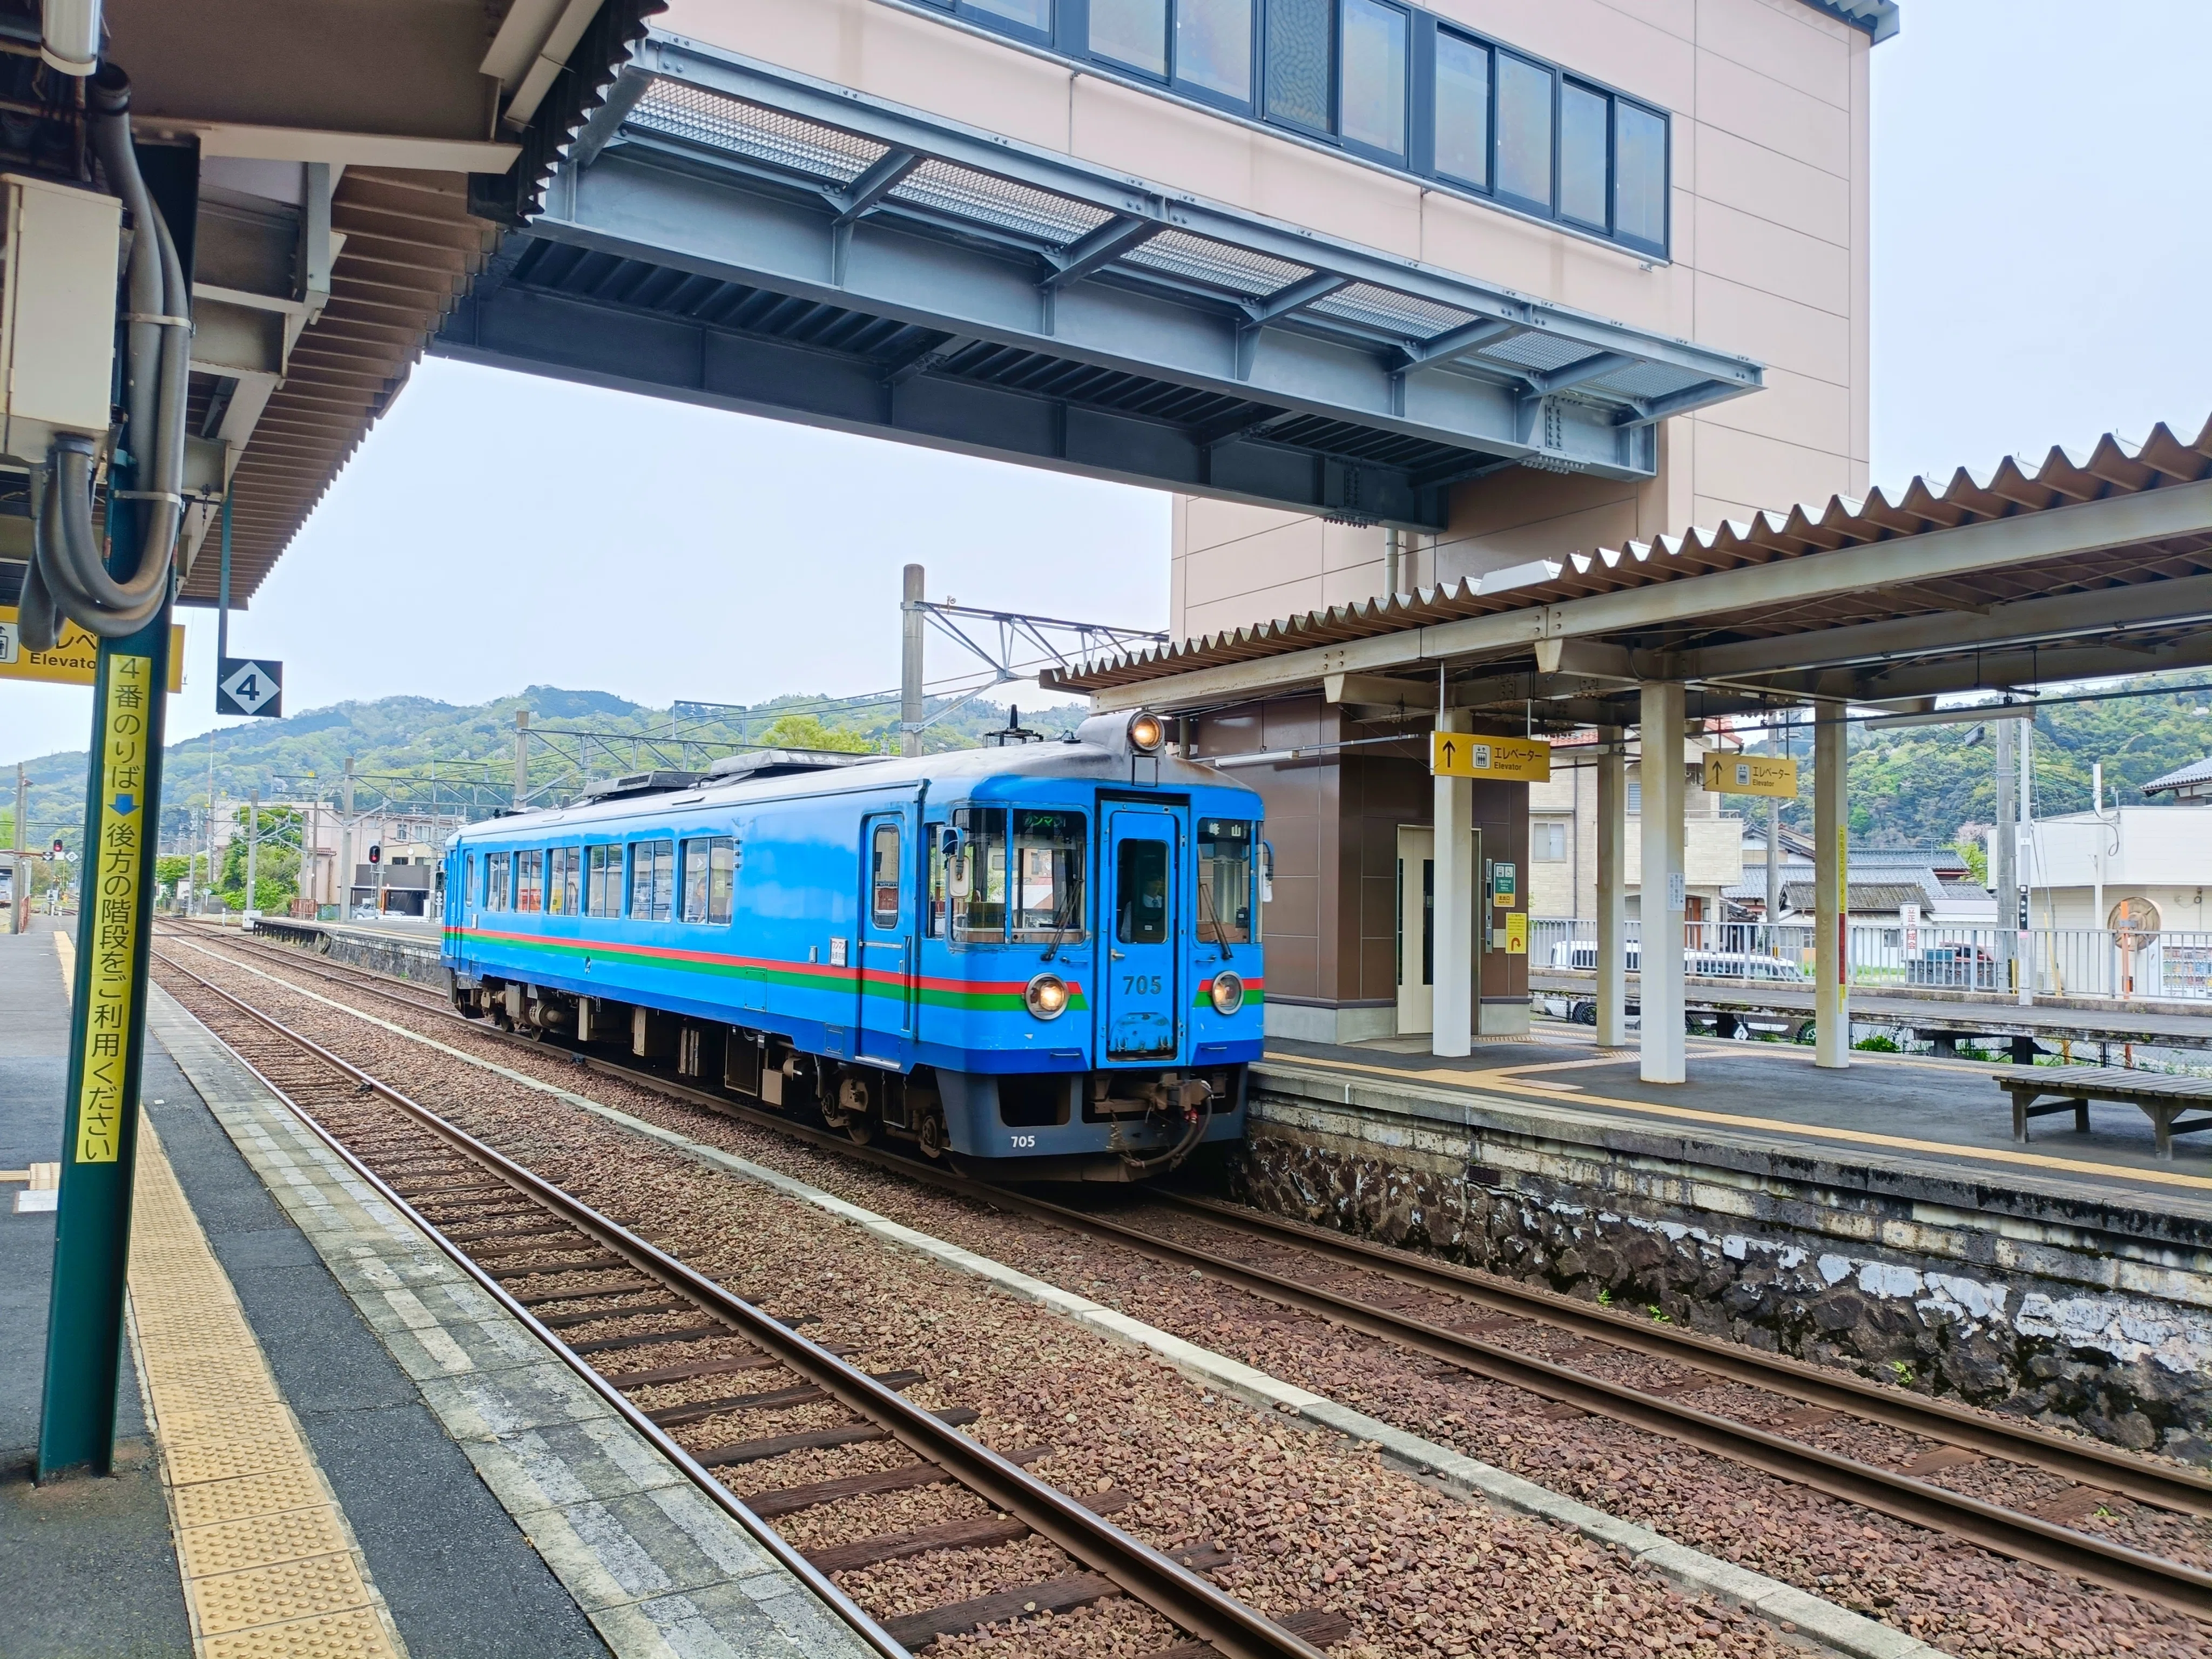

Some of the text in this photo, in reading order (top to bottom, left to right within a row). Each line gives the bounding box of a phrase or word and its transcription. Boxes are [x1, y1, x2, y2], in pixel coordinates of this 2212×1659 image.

[30, 652, 96, 670] Elevato
[236, 674, 260, 701] 4
[1494, 747, 1542, 762] エレベーター
[1494, 762, 1522, 771] Elevator
[1752, 766, 1790, 779] エレベーター
[1752, 779, 1775, 787] Elevator
[85, 657, 144, 1161] 4番のりば 後方の階段をご利用ください
[1122, 975, 1162, 995] 705
[1738, 1029, 1744, 1040] 2
[1010, 1135, 1035, 1148] 705
